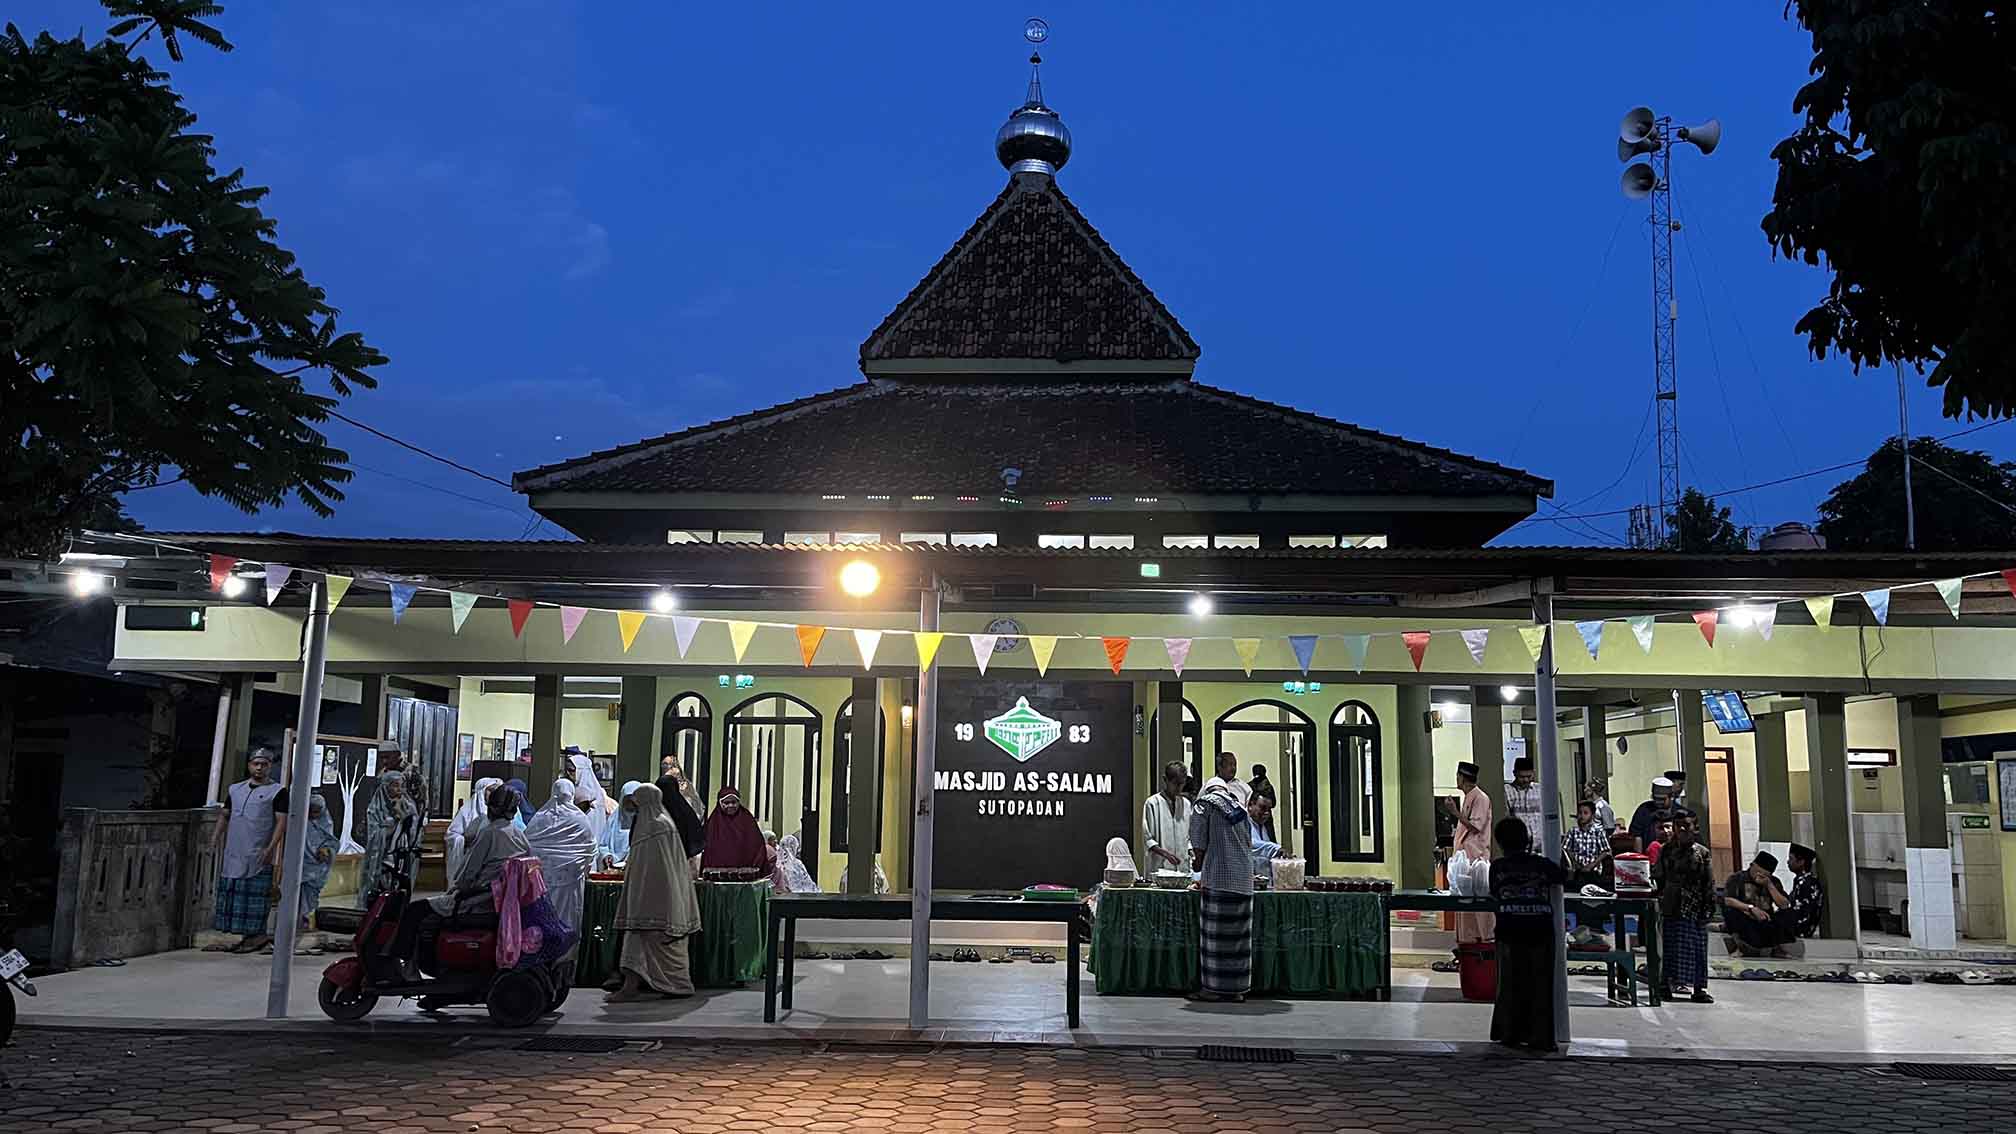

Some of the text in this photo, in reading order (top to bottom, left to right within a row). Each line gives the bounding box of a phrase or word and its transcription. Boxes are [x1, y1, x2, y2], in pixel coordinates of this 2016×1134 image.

[955, 723, 1090, 743] 19 83
[934, 772, 1111, 793] MASJID AS-SALAM
[979, 800, 1063, 815] SUTOPADAN
